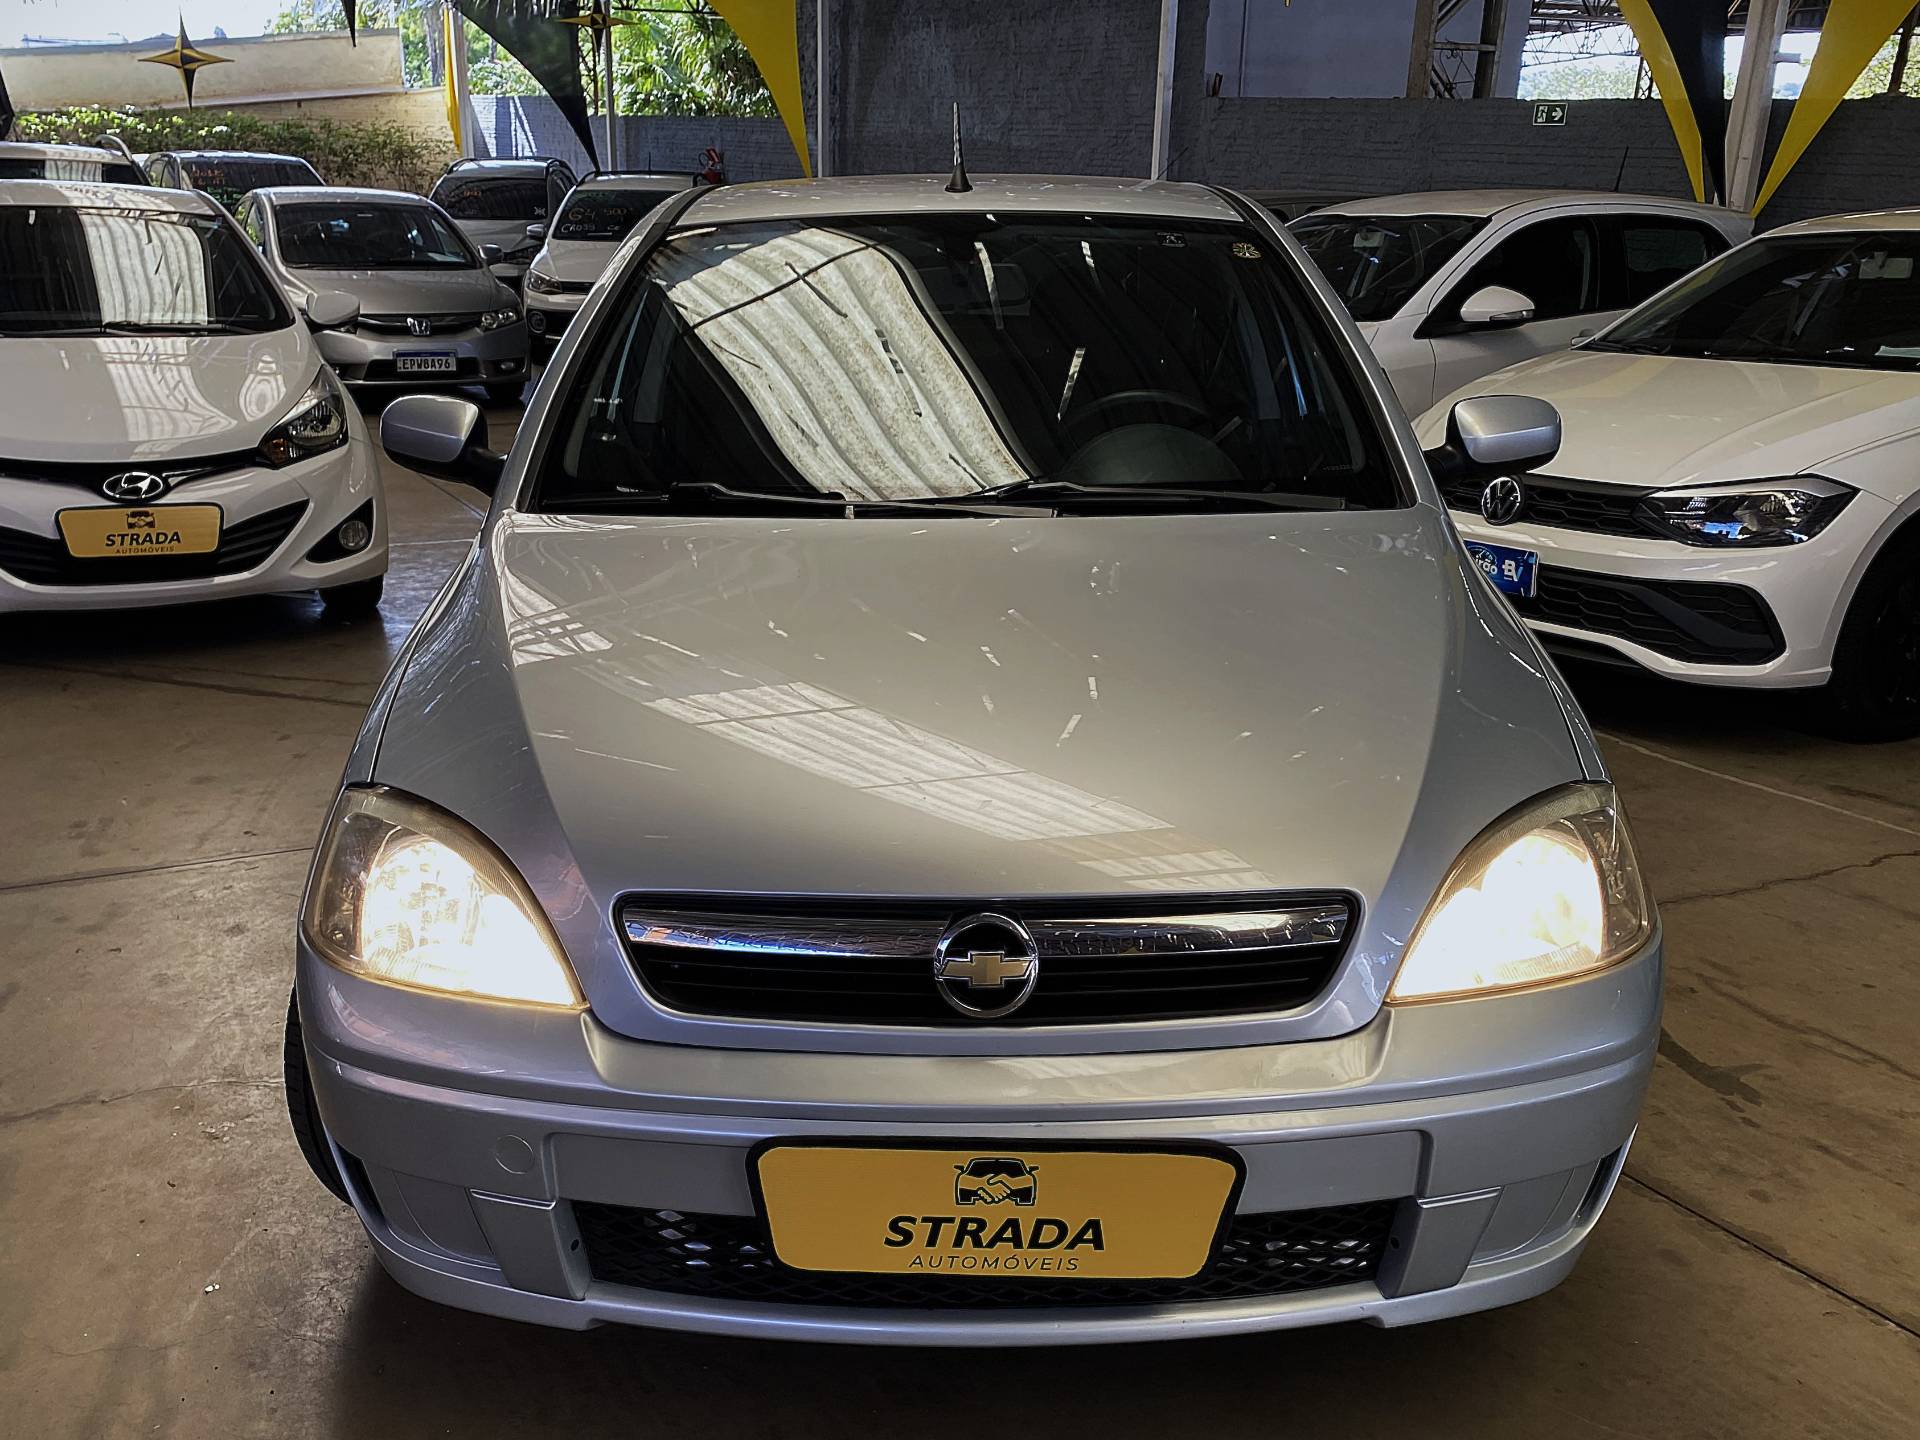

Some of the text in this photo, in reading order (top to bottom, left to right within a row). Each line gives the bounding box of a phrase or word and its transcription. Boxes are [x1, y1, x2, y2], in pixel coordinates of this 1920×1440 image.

[105, 531, 181, 547] STRADA
[883, 1215, 1105, 1251] STRADA
[908, 1254, 1080, 1272] AUTOMÓVEIS
